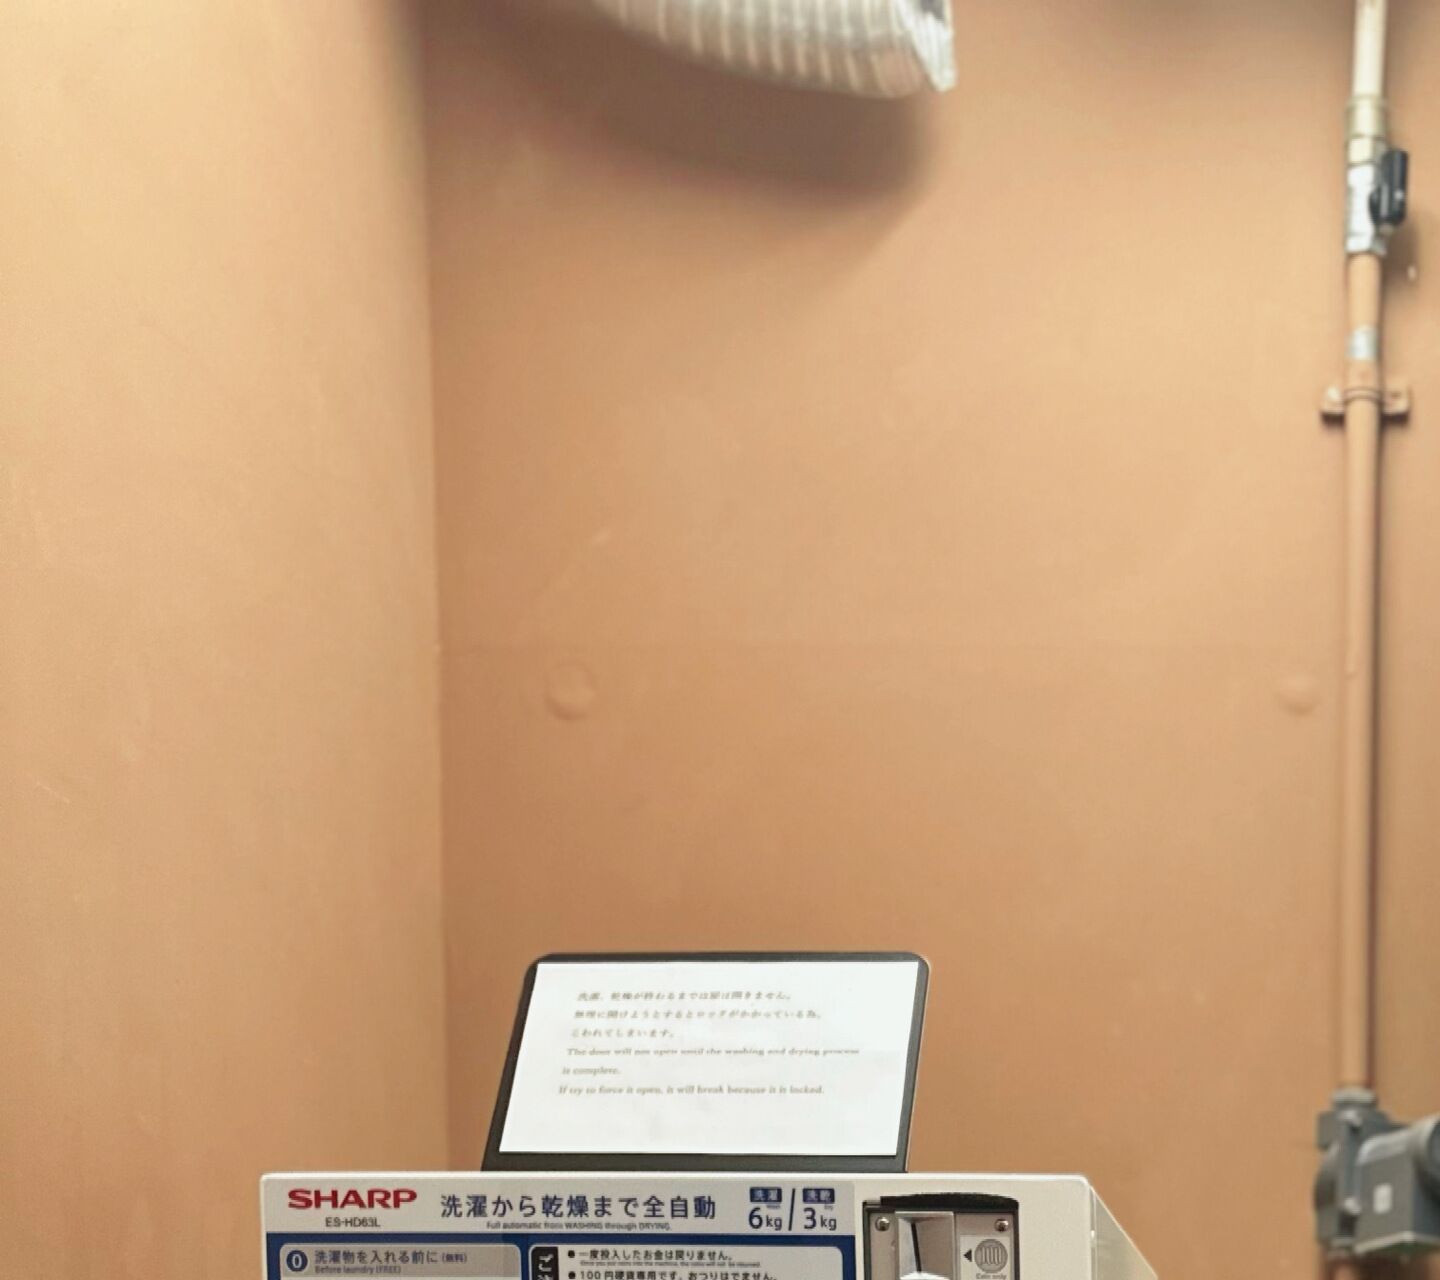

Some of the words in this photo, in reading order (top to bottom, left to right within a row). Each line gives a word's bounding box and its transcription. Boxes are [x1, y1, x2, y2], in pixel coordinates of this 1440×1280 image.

[287, 1187, 419, 1211] SHARP
[439, 1193, 718, 1221] 洗濯から乾燥まで全自動
[315, 1248, 438, 1269] 洗濯物を入れる前に
